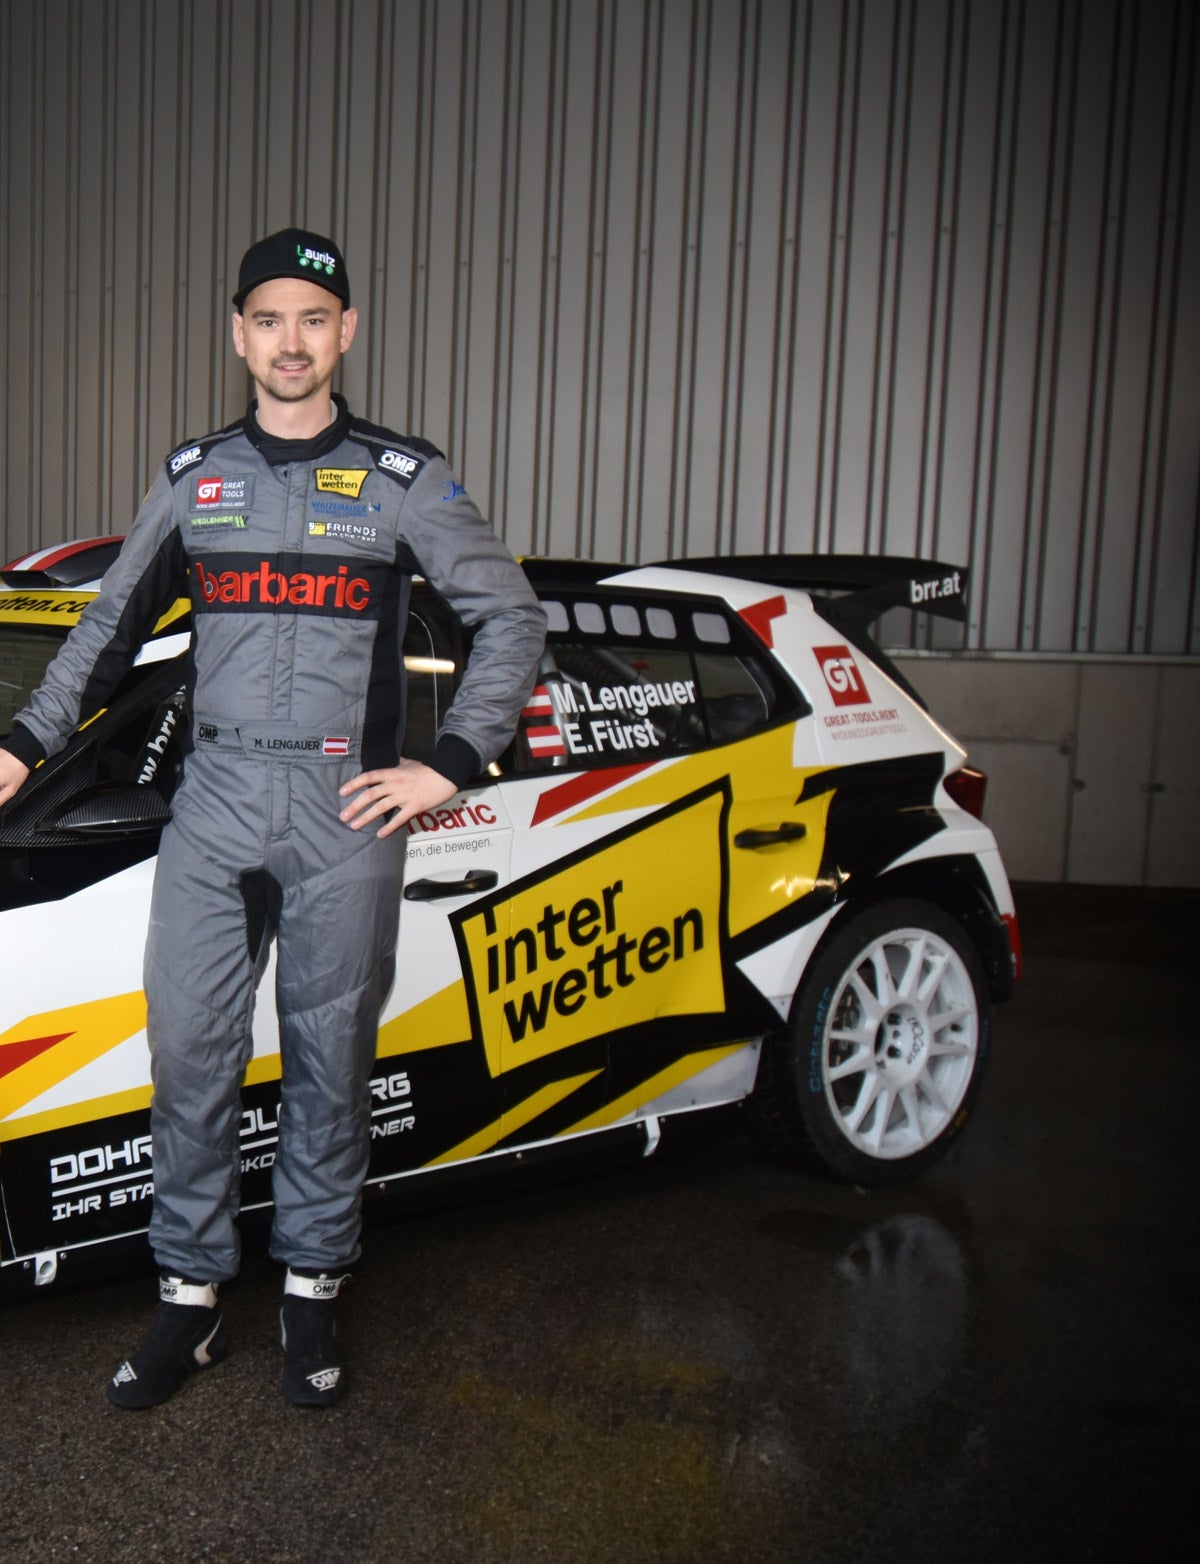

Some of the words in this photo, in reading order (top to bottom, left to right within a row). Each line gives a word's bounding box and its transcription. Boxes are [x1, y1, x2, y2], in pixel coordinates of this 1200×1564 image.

[171, 448, 201, 470] OMP
[381, 452, 416, 473] OMP
[319, 468, 344, 480] inter
[321, 480, 358, 489] wetten
[198, 483, 221, 498] GT
[326, 522, 377, 537] FRIENDS
[195, 561, 370, 611] barbaric
[911, 572, 960, 602] brr.at
[823, 658, 859, 692] GT
[824, 710, 899, 727] GREAT-TOOLS.RENT
[254, 739, 265, 748] M.
[267, 739, 320, 750] LENGAUER
[408, 799, 497, 835] rbaric
[426, 844, 442, 856] die
[444, 838, 493, 852] bewegen.
[484, 880, 623, 994] inter
[504, 908, 704, 1043] wetten
[52, 1194, 102, 1221] IHR
[109, 1182, 155, 1208] STA
[313, 1284, 336, 1295] OMP
